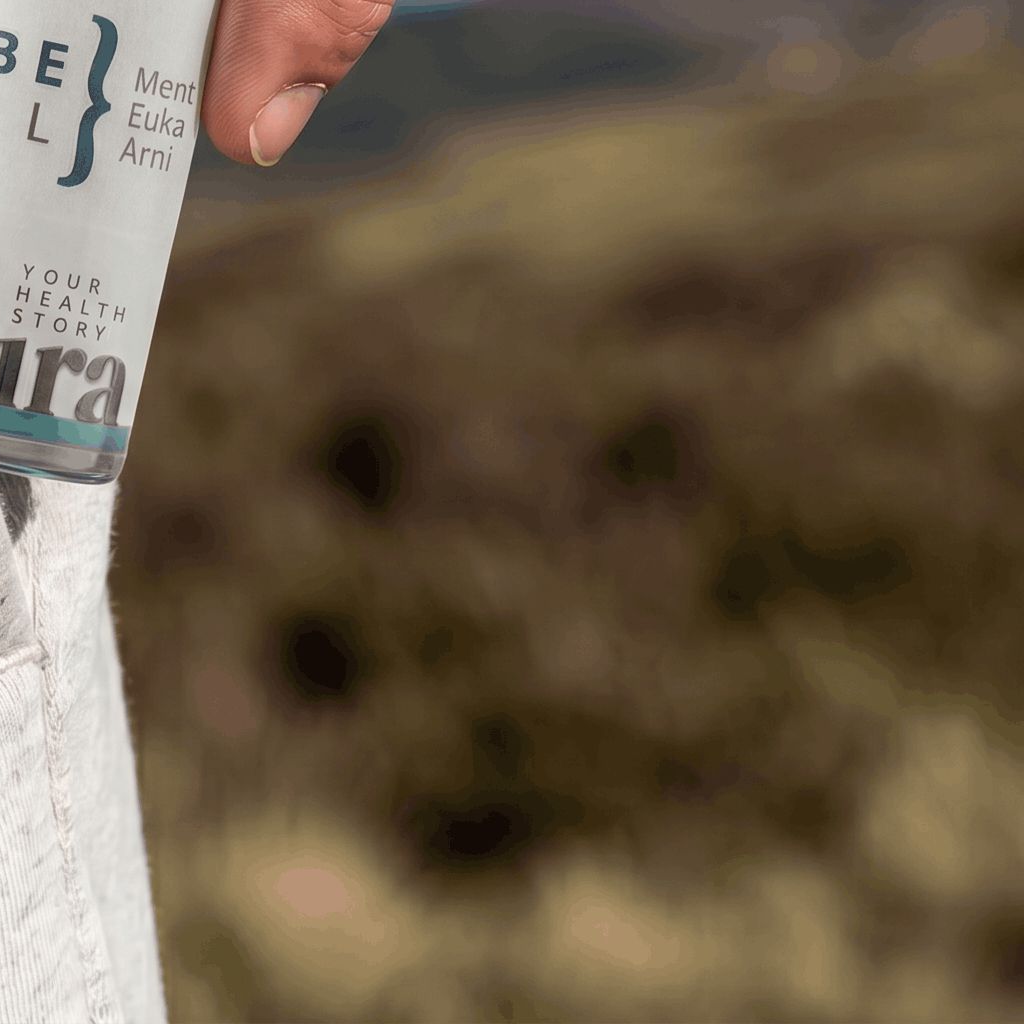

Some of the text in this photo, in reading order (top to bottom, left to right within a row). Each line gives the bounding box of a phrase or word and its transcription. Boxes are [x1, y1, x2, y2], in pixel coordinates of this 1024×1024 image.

[134, 67, 196, 105] Ment
[128, 102, 185, 138] Euka
[118, 136, 173, 172] Arni
[23, 263, 100, 295] YOUR
[16, 285, 126, 323] HEALTH
[11, 308, 106, 341] STORY
